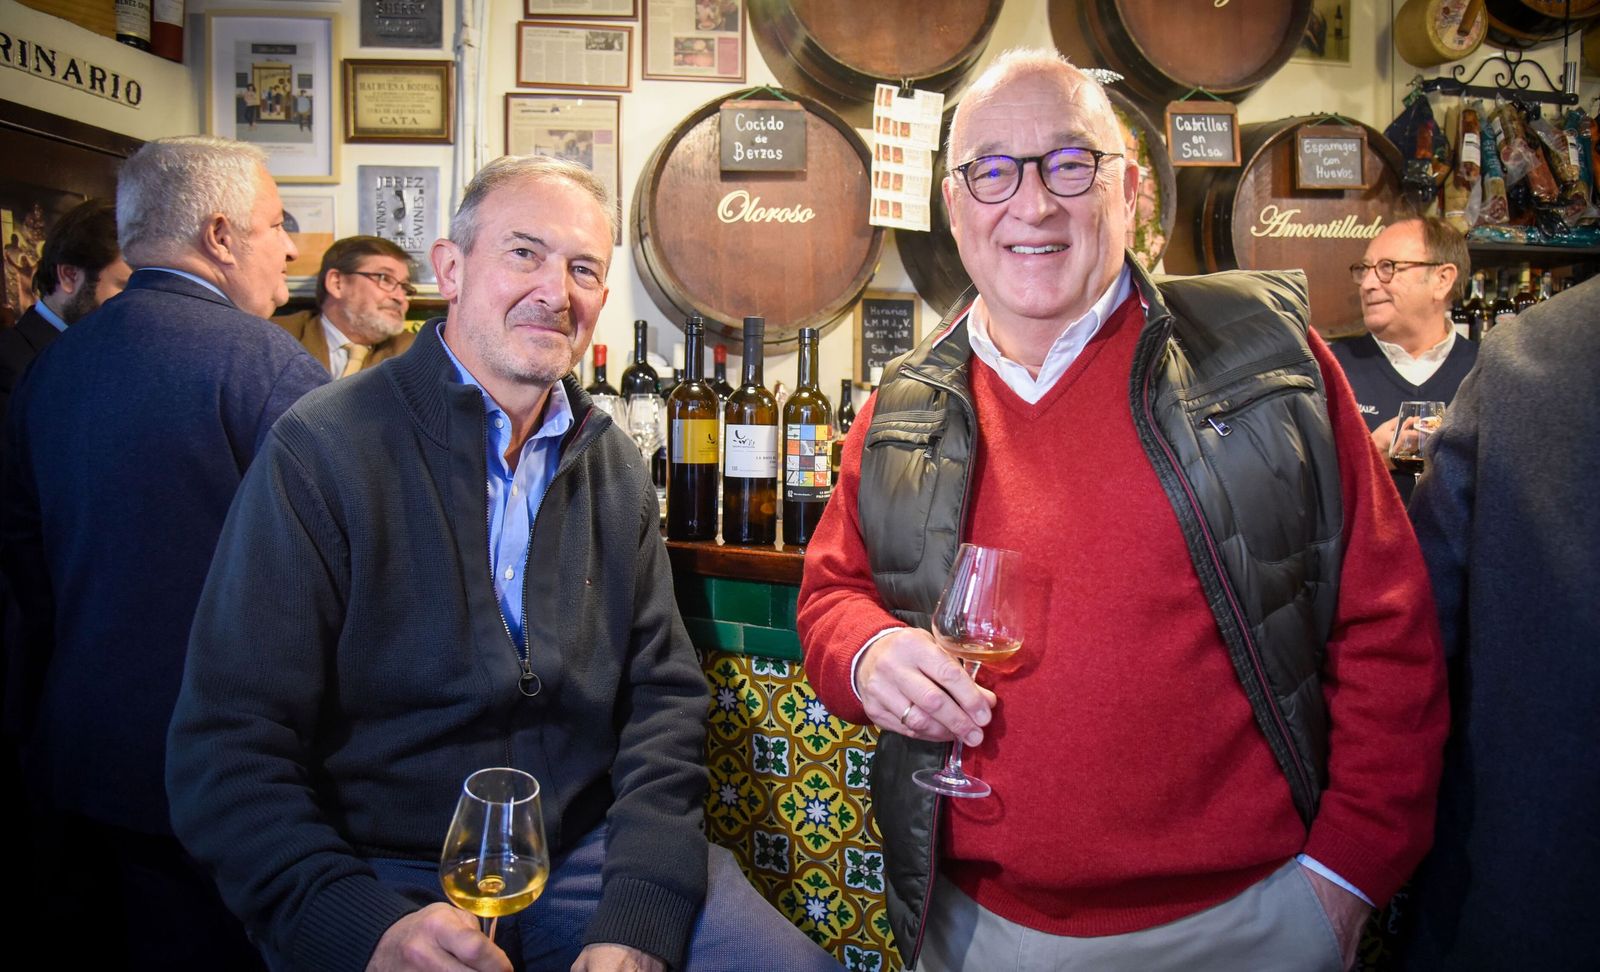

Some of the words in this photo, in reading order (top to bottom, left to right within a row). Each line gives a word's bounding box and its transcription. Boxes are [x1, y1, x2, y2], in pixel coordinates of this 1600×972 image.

[735, 112, 785, 132] Cocido
[1175, 115, 1229, 132] Cabrillas
[754, 134, 769, 144] de
[1191, 134, 1207, 145] en
[732, 141, 784, 162] Berzas
[1181, 141, 1224, 159] Salsa
[1322, 156, 1341, 167] con
[1315, 164, 1354, 180] Huevos
[376, 175, 424, 191] JEREZ
[376, 200, 386, 230] VINOS
[716, 189, 817, 224] Oloroso
[413, 195, 425, 237] WINES
